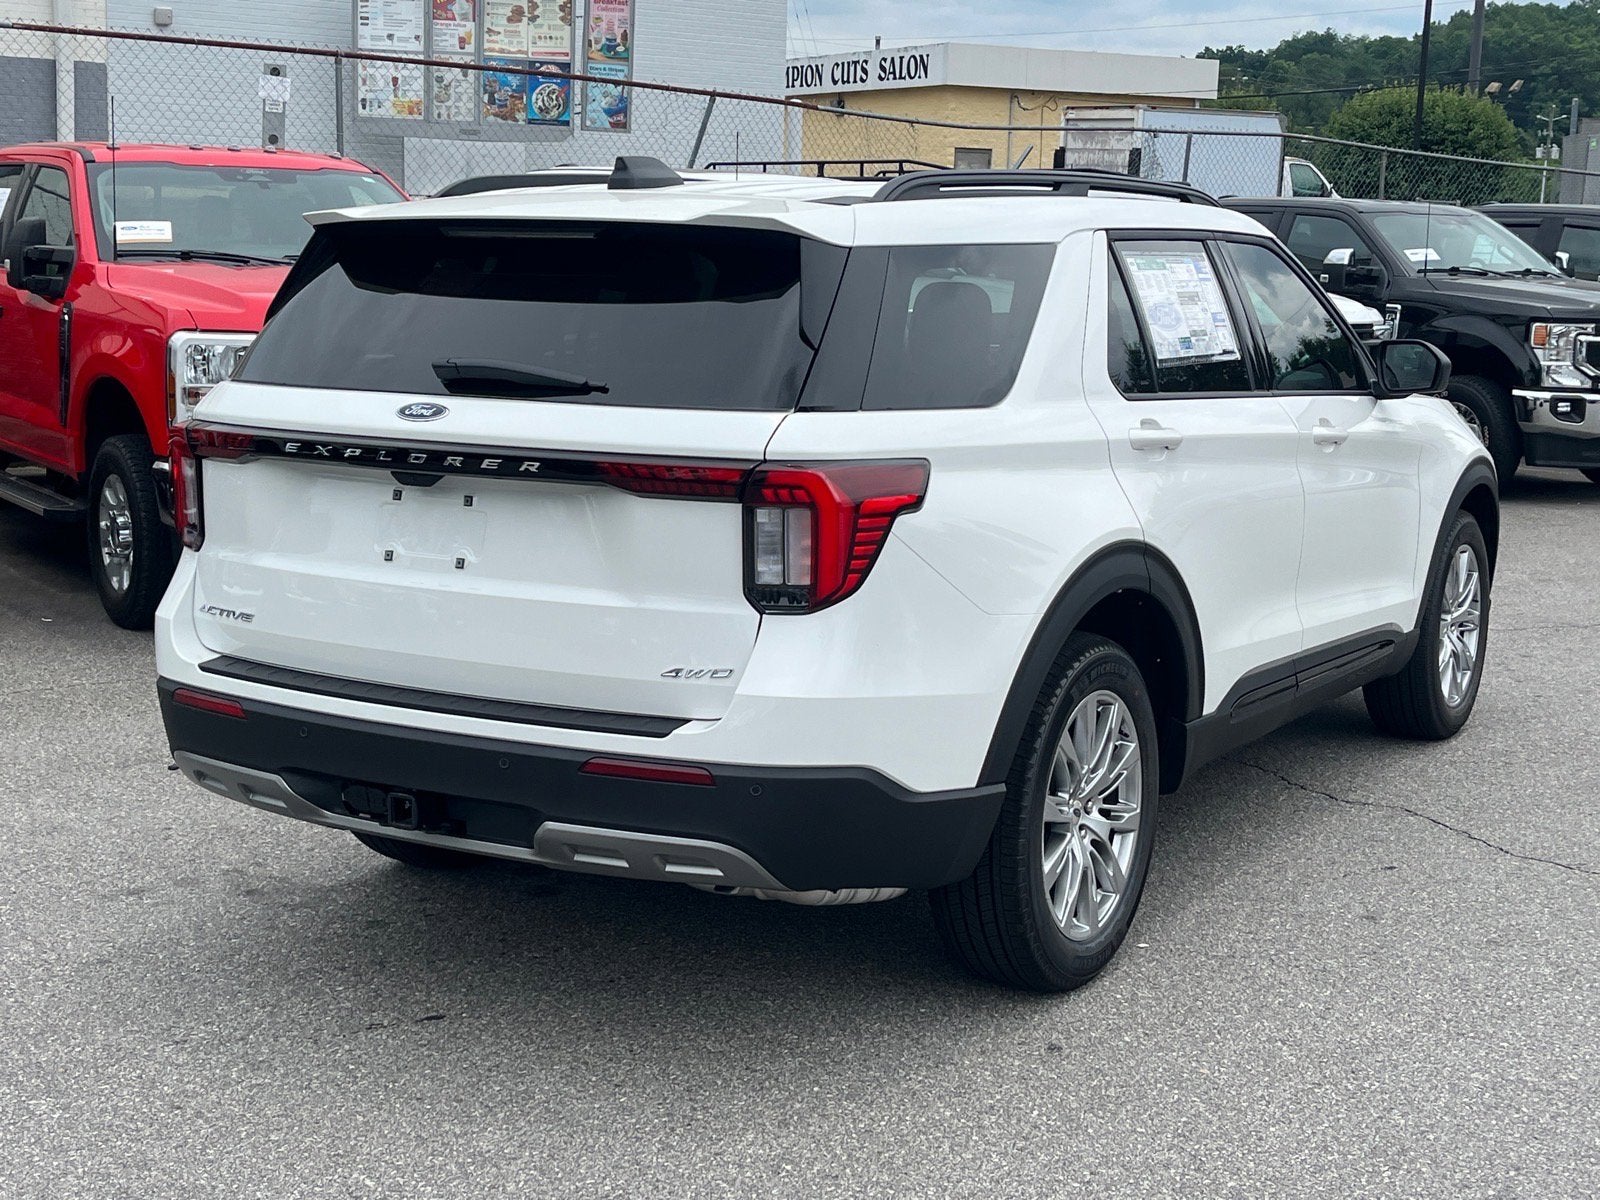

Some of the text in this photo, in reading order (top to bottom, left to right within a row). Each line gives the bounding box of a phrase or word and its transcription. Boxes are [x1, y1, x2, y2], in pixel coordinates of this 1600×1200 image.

[831, 59, 869, 86] CUTS
[877, 53, 930, 82] SALON
[405, 402, 434, 418] Ford
[285, 442, 541, 473] EXPLORER
[660, 668, 734, 679] 4WD
